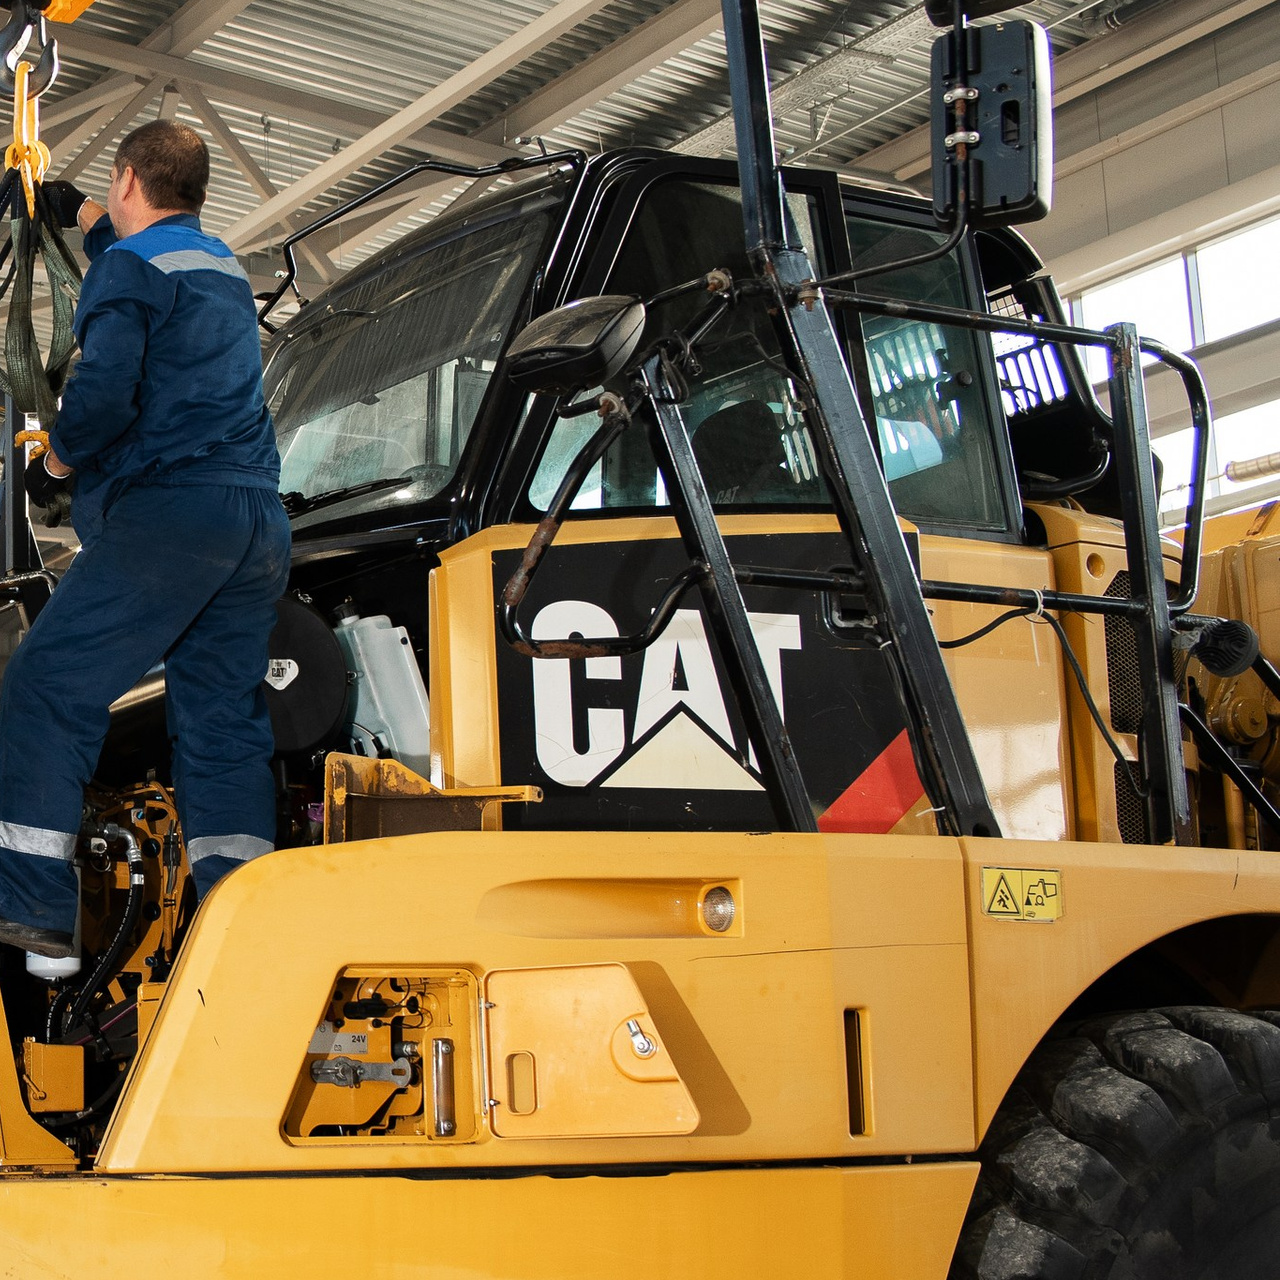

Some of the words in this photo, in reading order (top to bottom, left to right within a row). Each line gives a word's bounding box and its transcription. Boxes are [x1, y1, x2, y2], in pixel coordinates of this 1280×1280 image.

[272, 667, 286, 677] CAT
[531, 600, 802, 788] CAT
[351, 1035, 366, 1043] 24V
